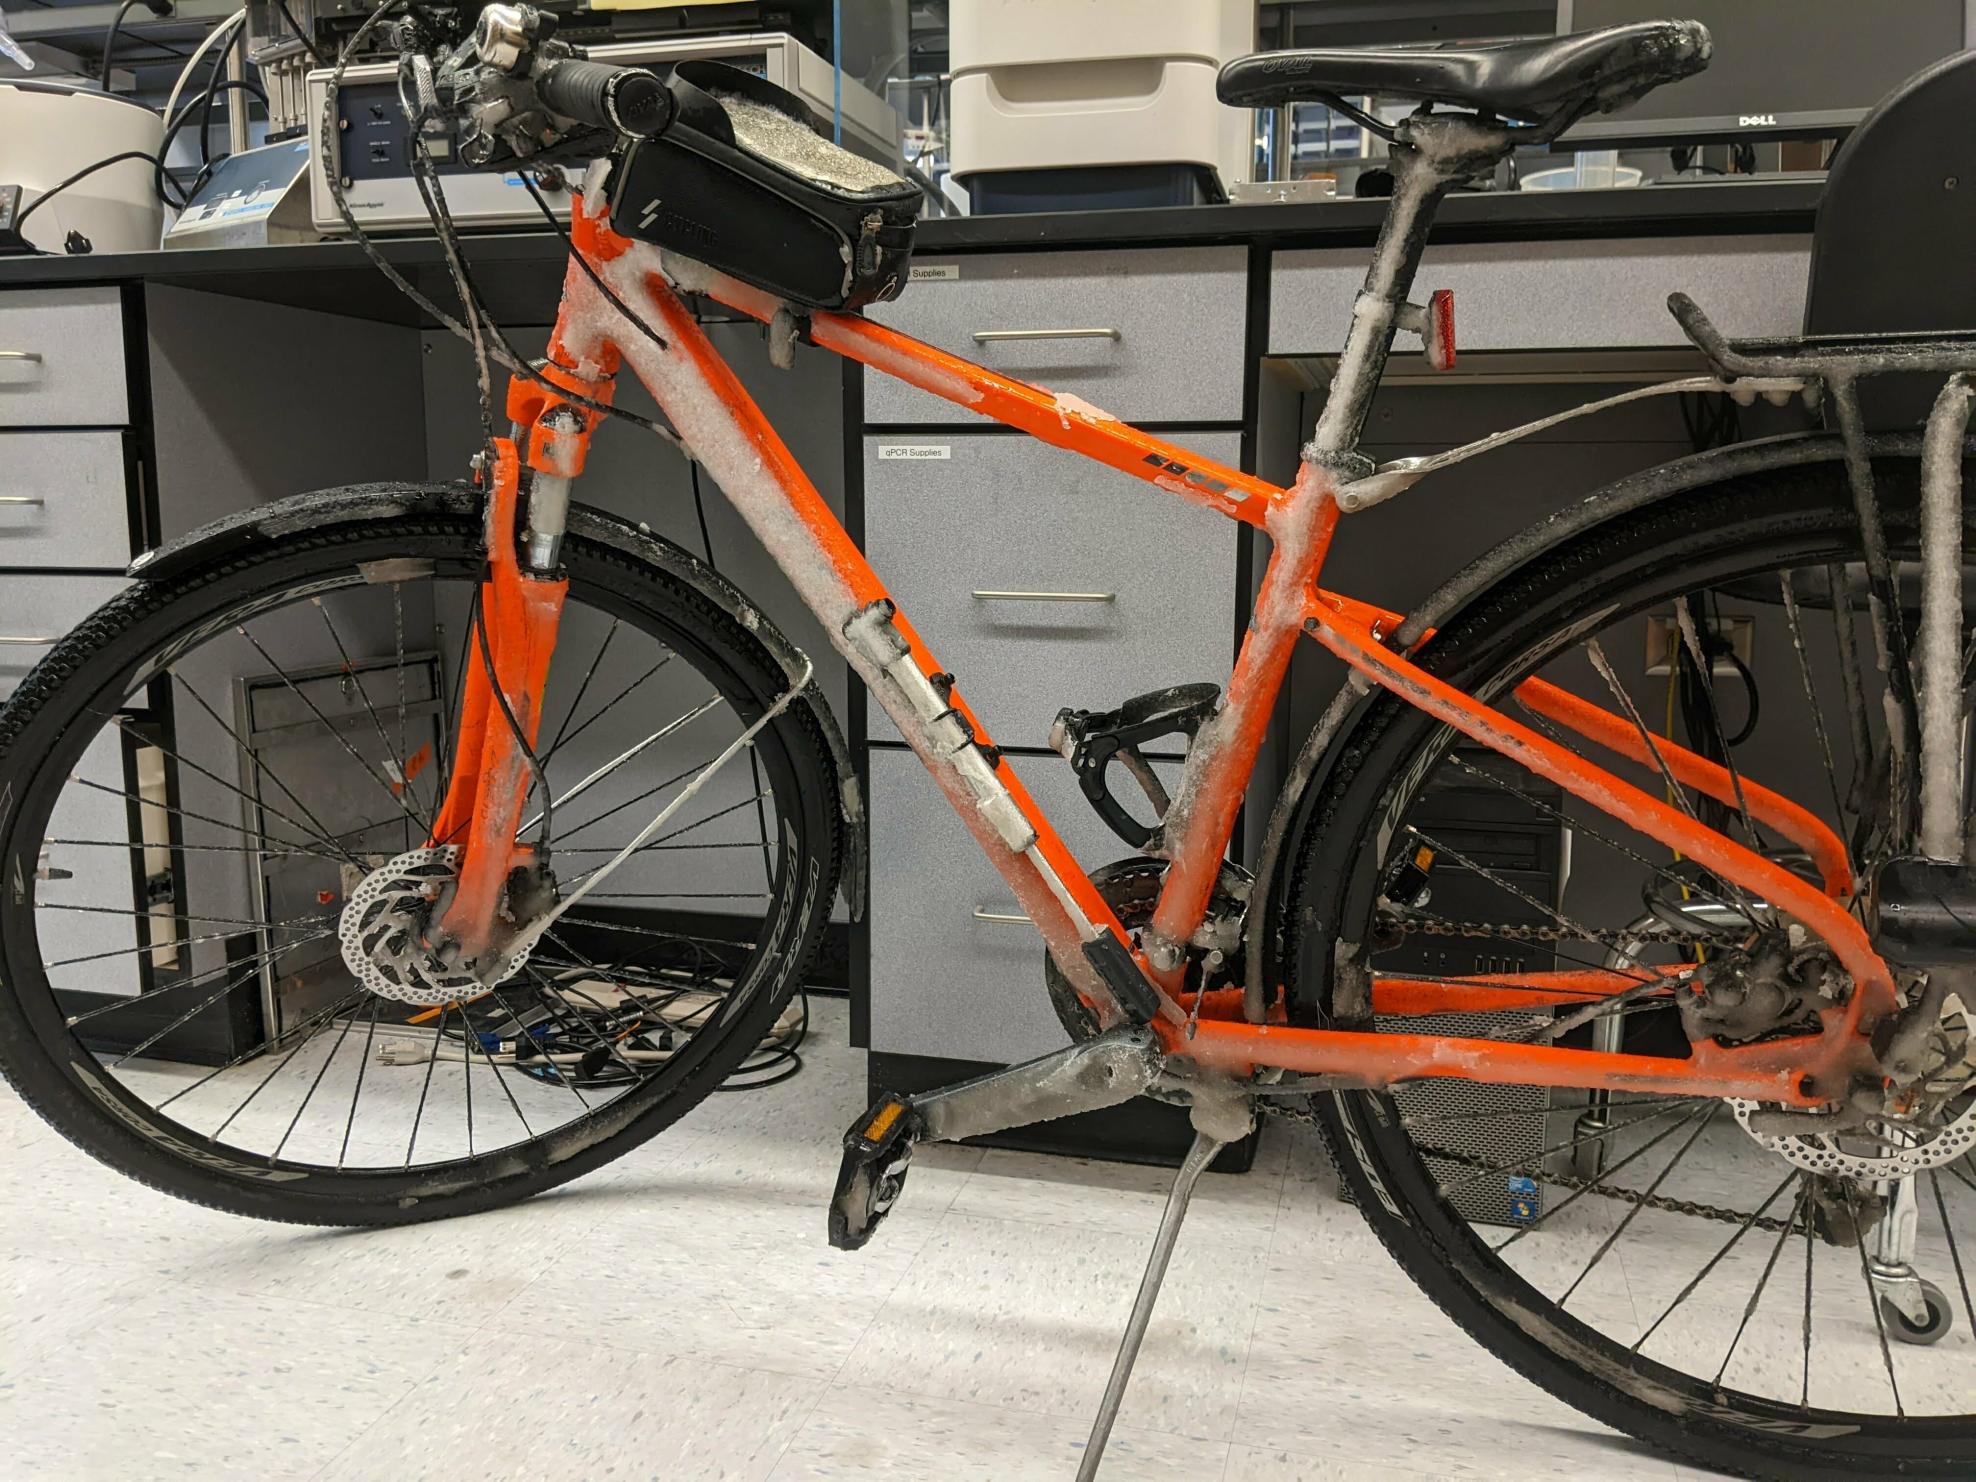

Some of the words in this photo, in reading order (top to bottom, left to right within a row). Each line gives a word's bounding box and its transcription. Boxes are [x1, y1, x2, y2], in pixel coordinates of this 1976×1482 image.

[1738, 114, 1777, 127] DELL
[912, 268, 946, 278] Supplies
[885, 448, 908, 457] qPCR
[909, 448, 942, 457] Supplies
[1381, 722, 1456, 830] VER
[1479, 626, 1574, 696] CORSA
